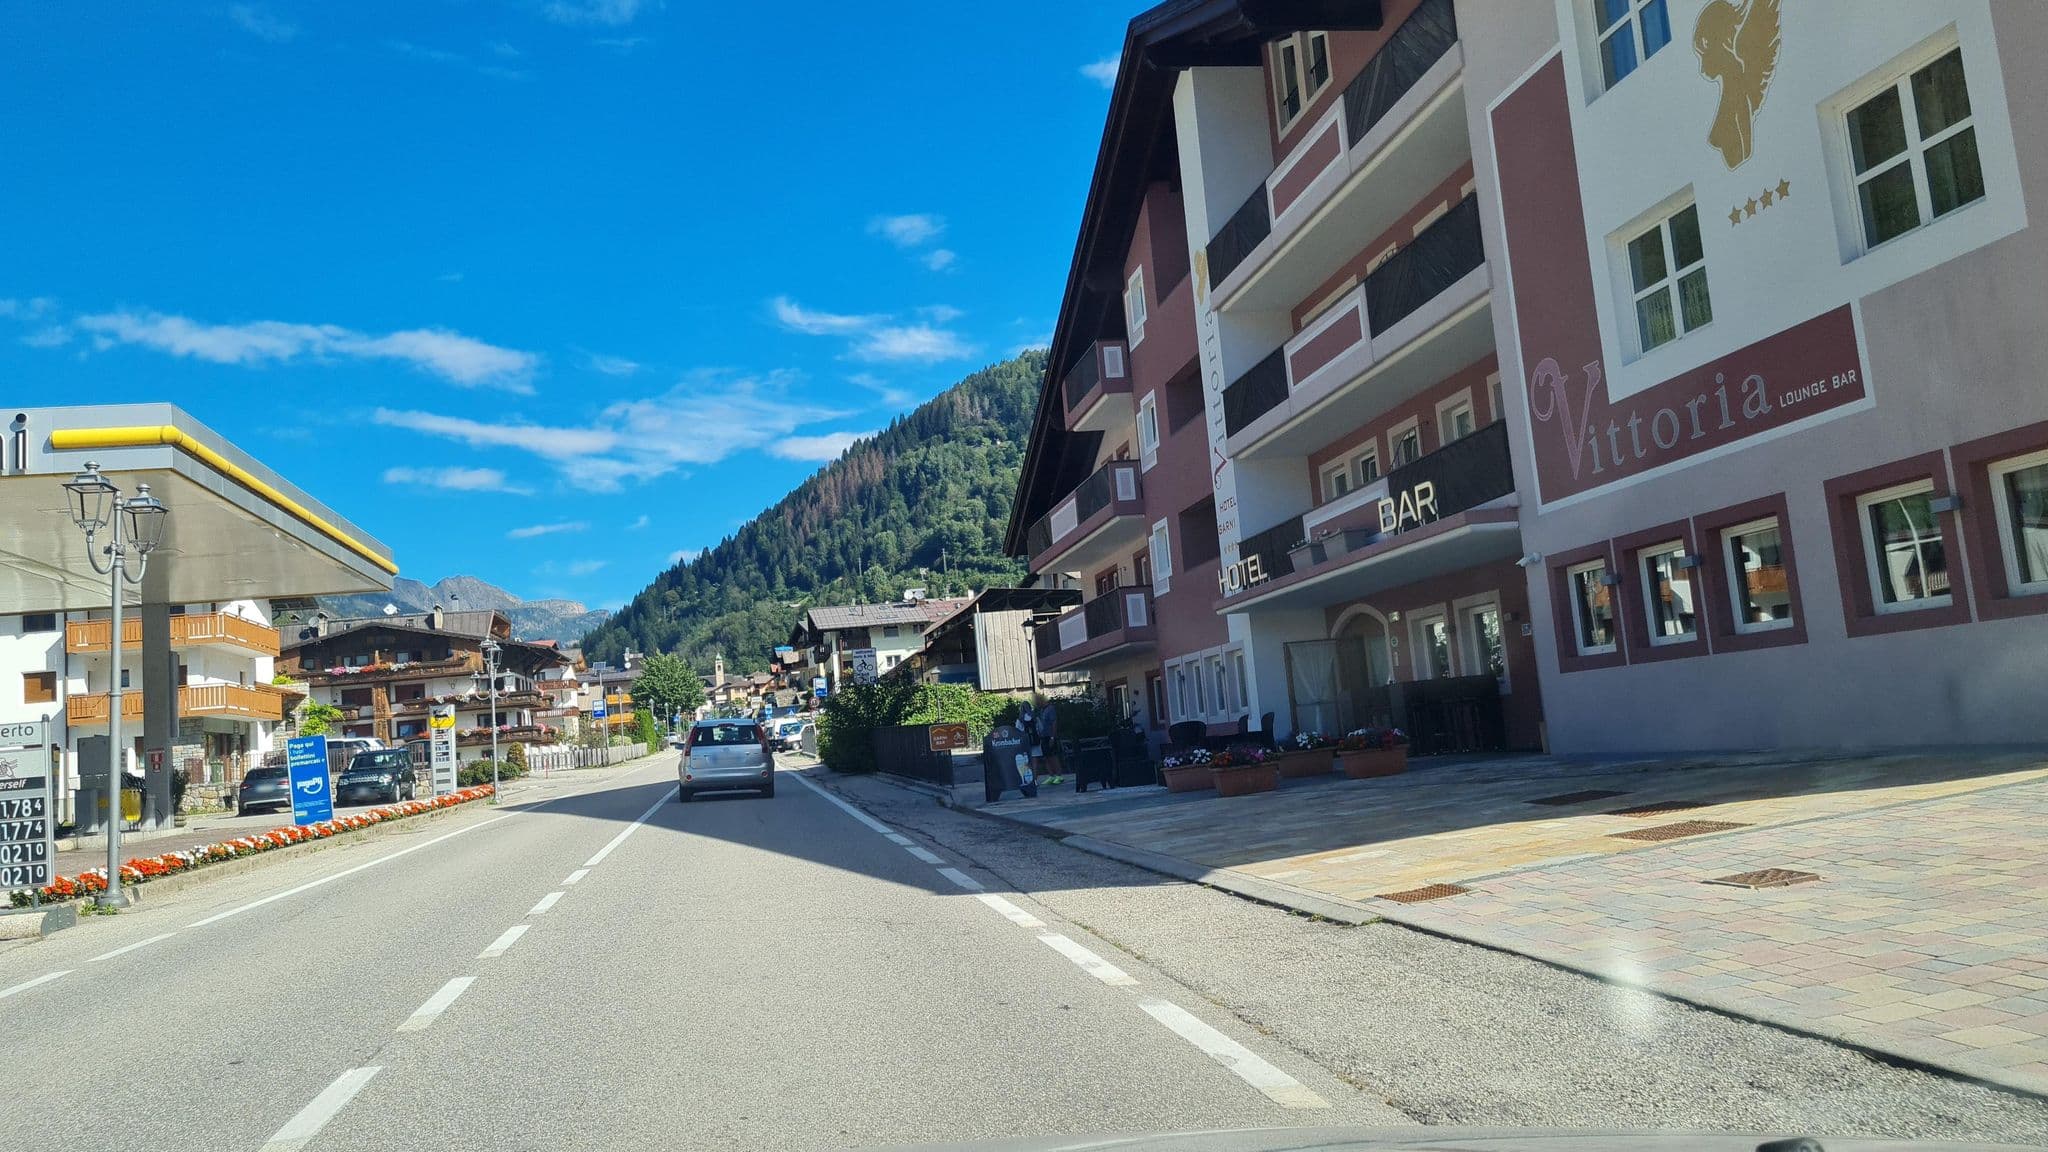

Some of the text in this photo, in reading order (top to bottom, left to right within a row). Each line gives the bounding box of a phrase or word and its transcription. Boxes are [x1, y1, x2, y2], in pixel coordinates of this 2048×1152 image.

[1779, 369, 1857, 408] LOUNGE BAR
[1531, 358, 1772, 480] Vittoria
[1220, 497, 1237, 512] HOTEL
[1378, 481, 1436, 533] BAR
[1218, 518, 1236, 535] GARNI
[1218, 553, 1268, 594] HOTEL
